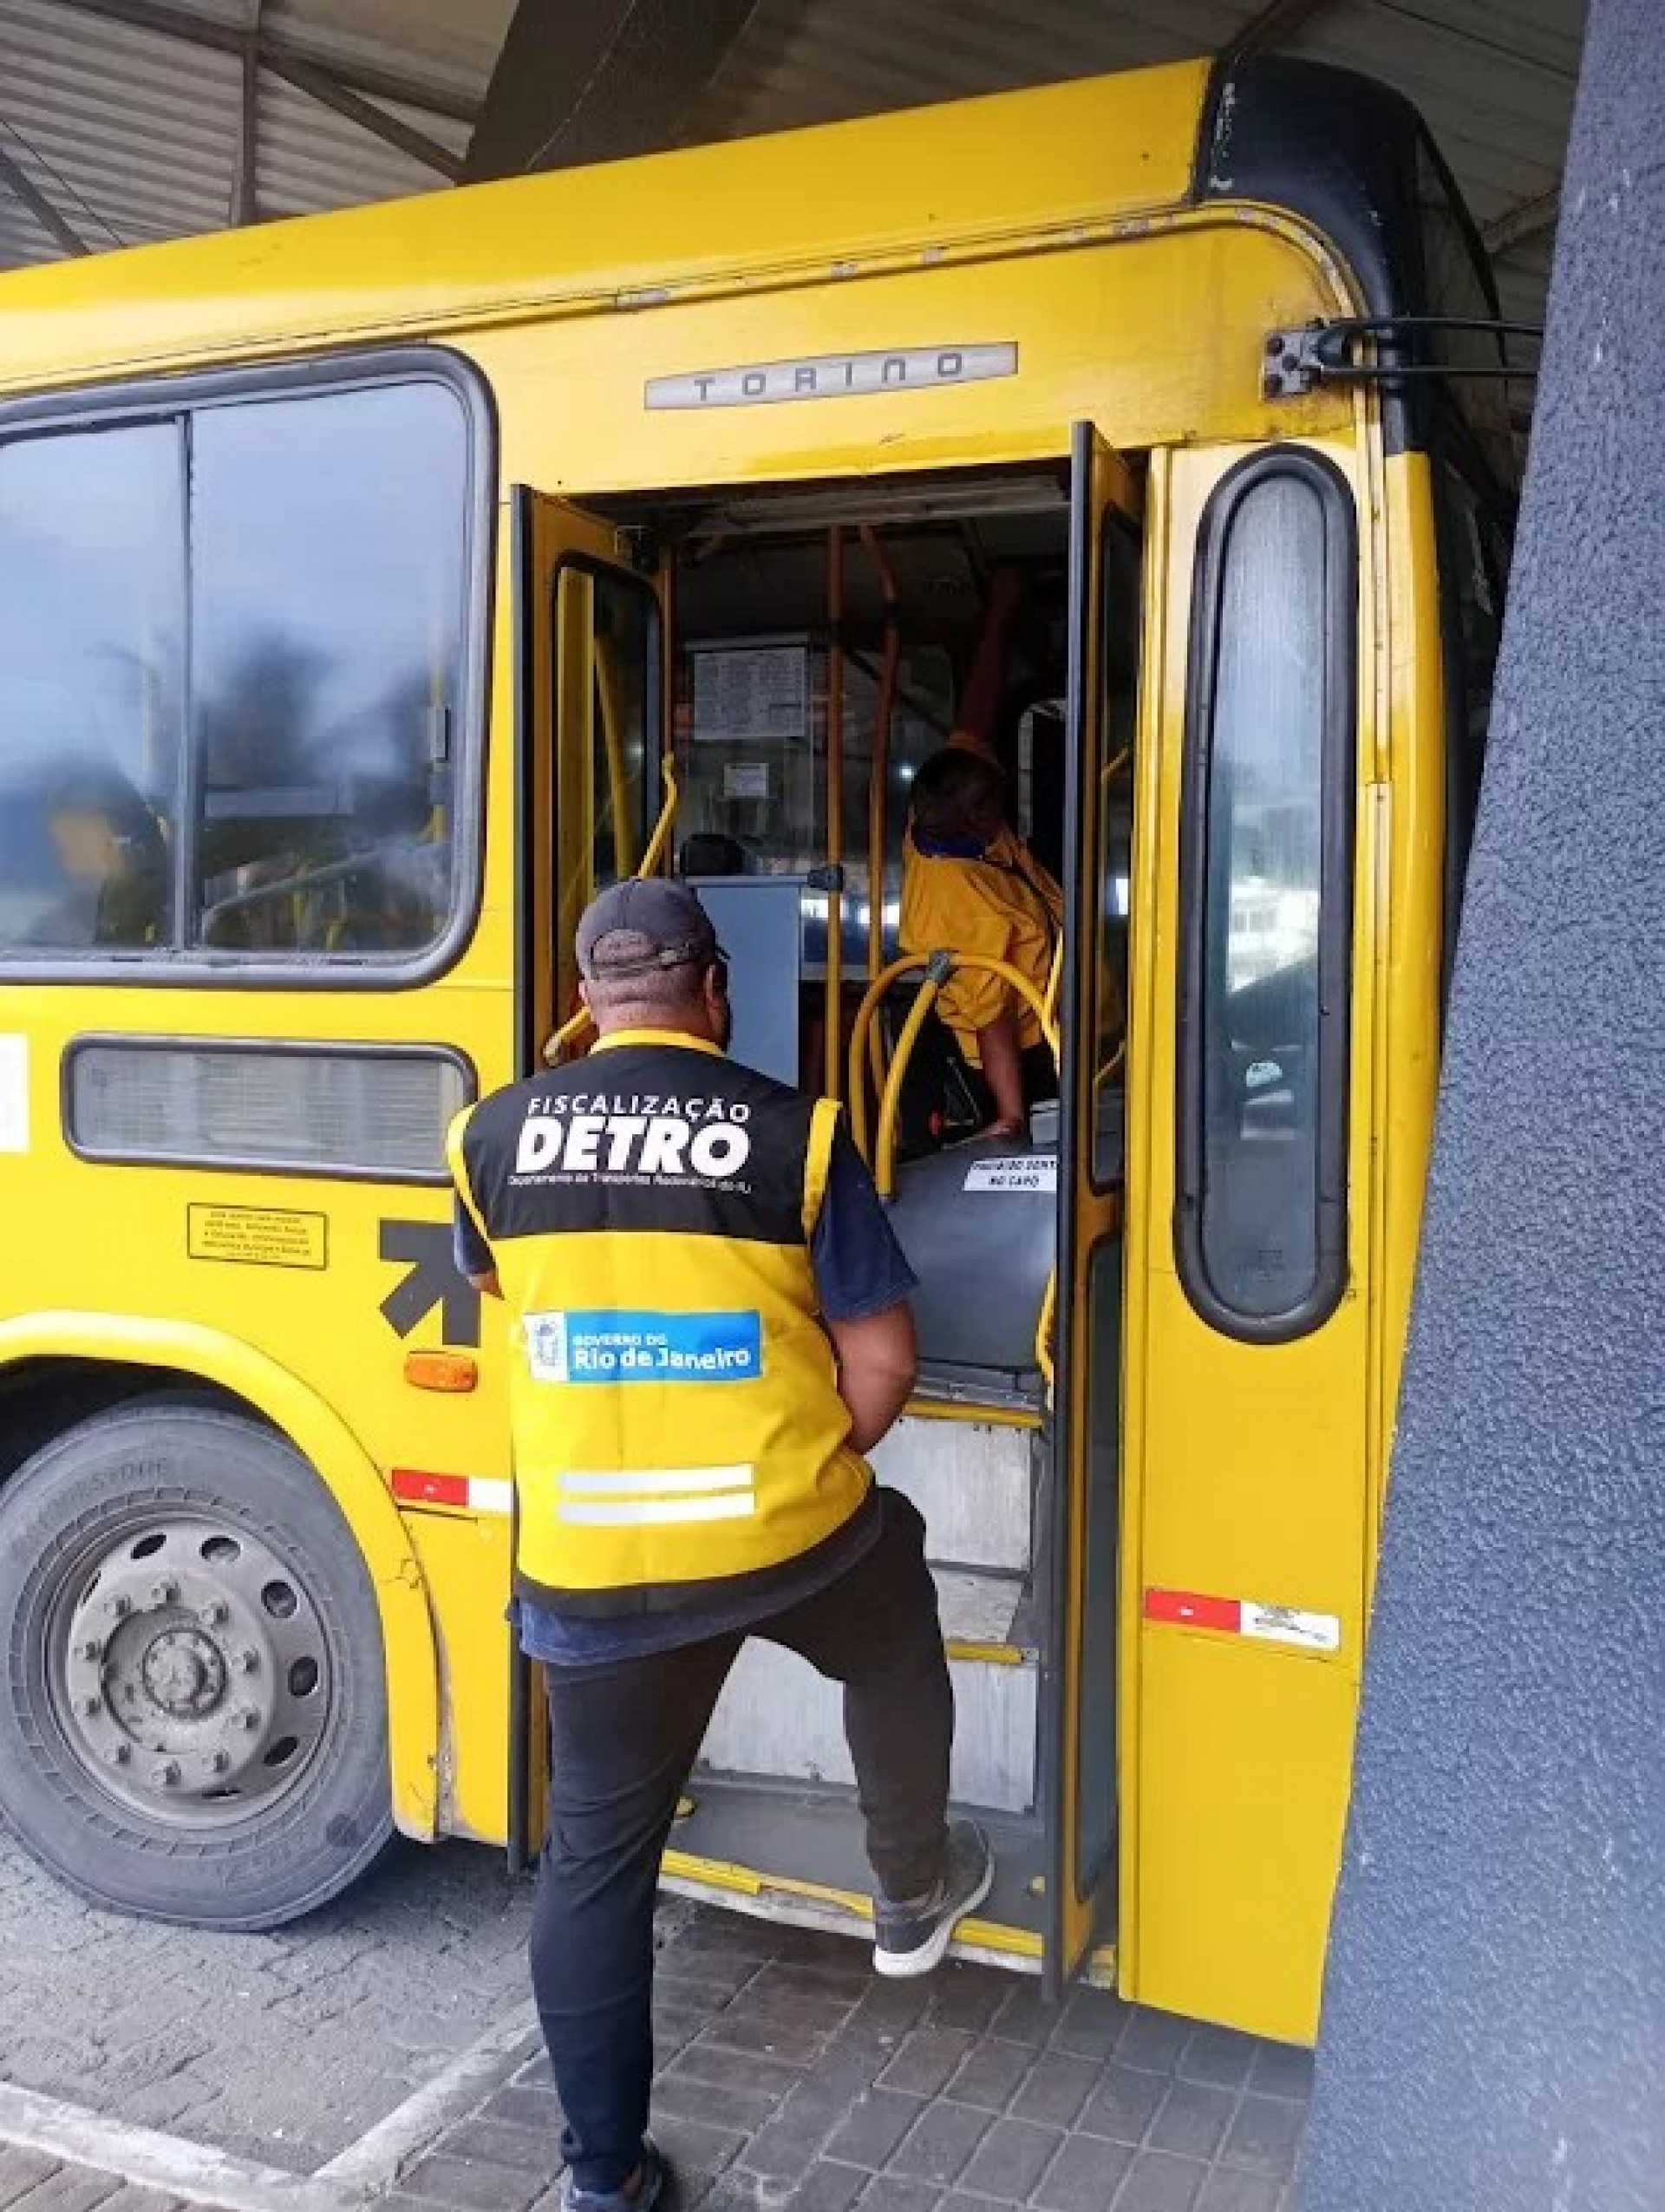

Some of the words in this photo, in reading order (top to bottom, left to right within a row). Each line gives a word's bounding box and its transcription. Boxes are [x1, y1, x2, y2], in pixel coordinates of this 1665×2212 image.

[694, 352, 963, 401] TORINO
[526, 1092, 751, 1124] FISCALIZAÇÃO
[515, 1115, 751, 1177] DETRO
[572, 1332, 642, 1346] GOVERNO
[646, 1332, 669, 1346] DO
[574, 1346, 616, 1369] Rio
[619, 1347, 653, 1367] de
[656, 1347, 752, 1370] Janeiro
